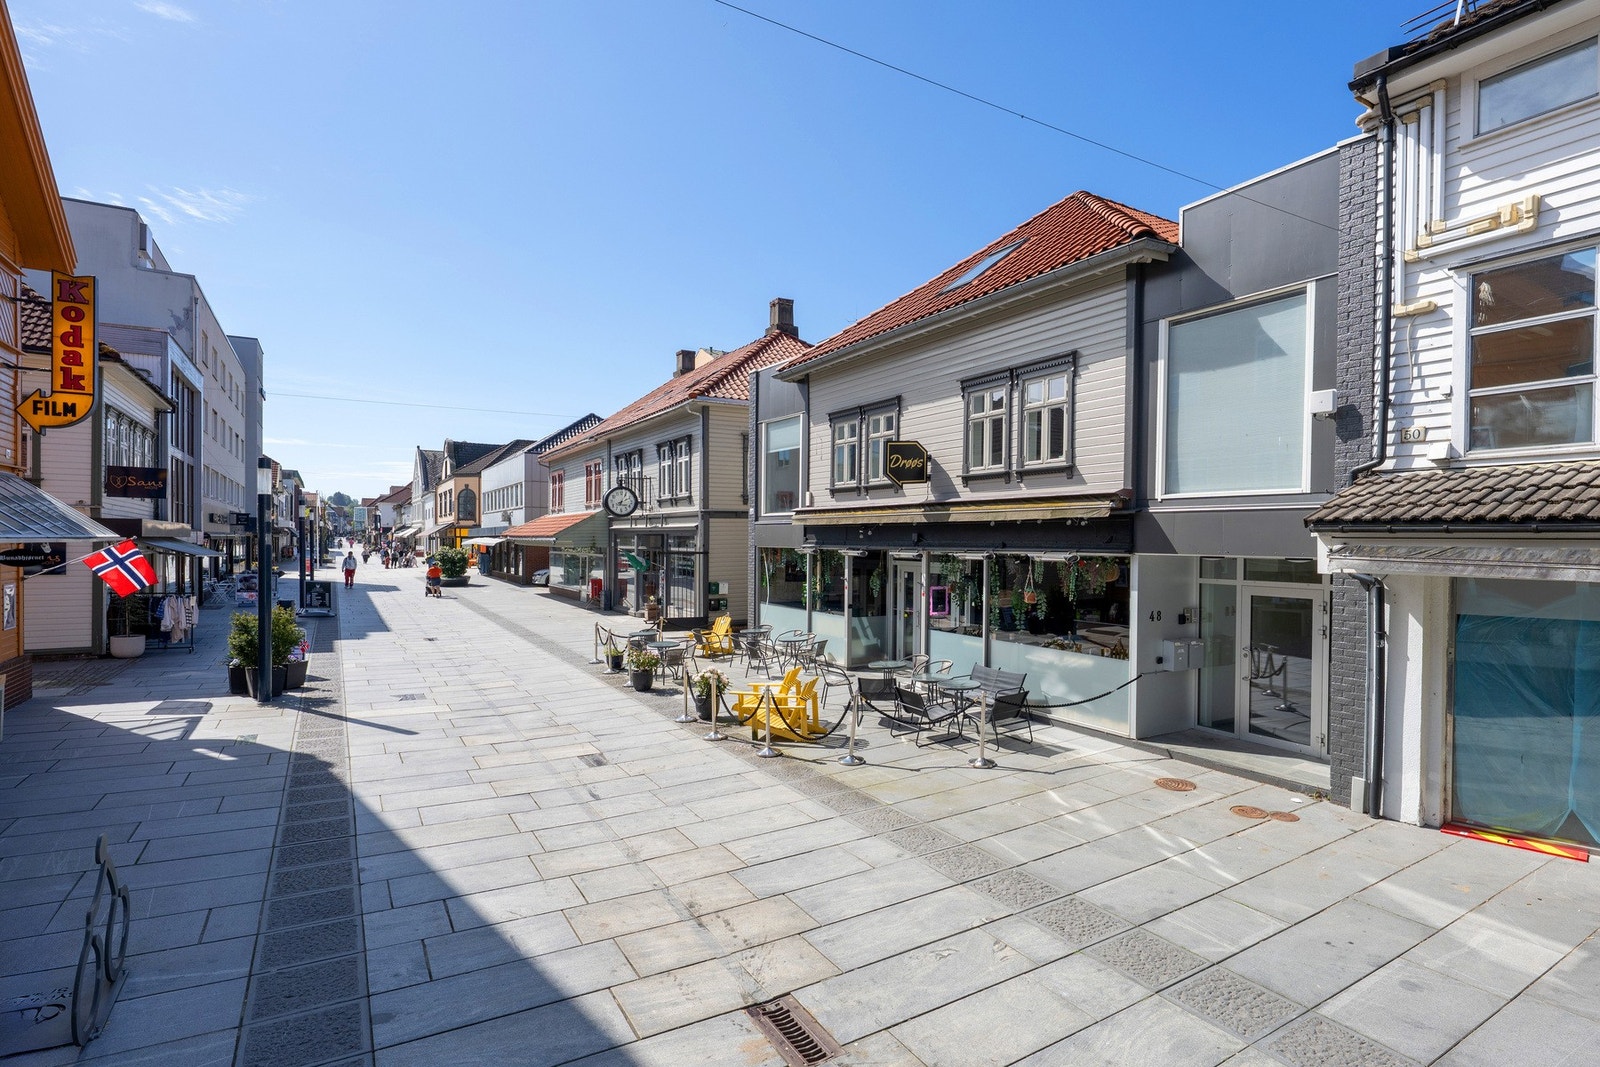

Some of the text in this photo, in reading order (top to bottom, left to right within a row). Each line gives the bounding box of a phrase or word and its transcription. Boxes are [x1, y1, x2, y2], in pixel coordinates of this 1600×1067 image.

[57, 279, 89, 391] Kodak
[32, 400, 77, 417] FILM
[1404, 429, 1421, 440] 50
[890, 454, 923, 469] Drøøs
[128, 476, 163, 487] Sans
[1149, 611, 1162, 622] 48
